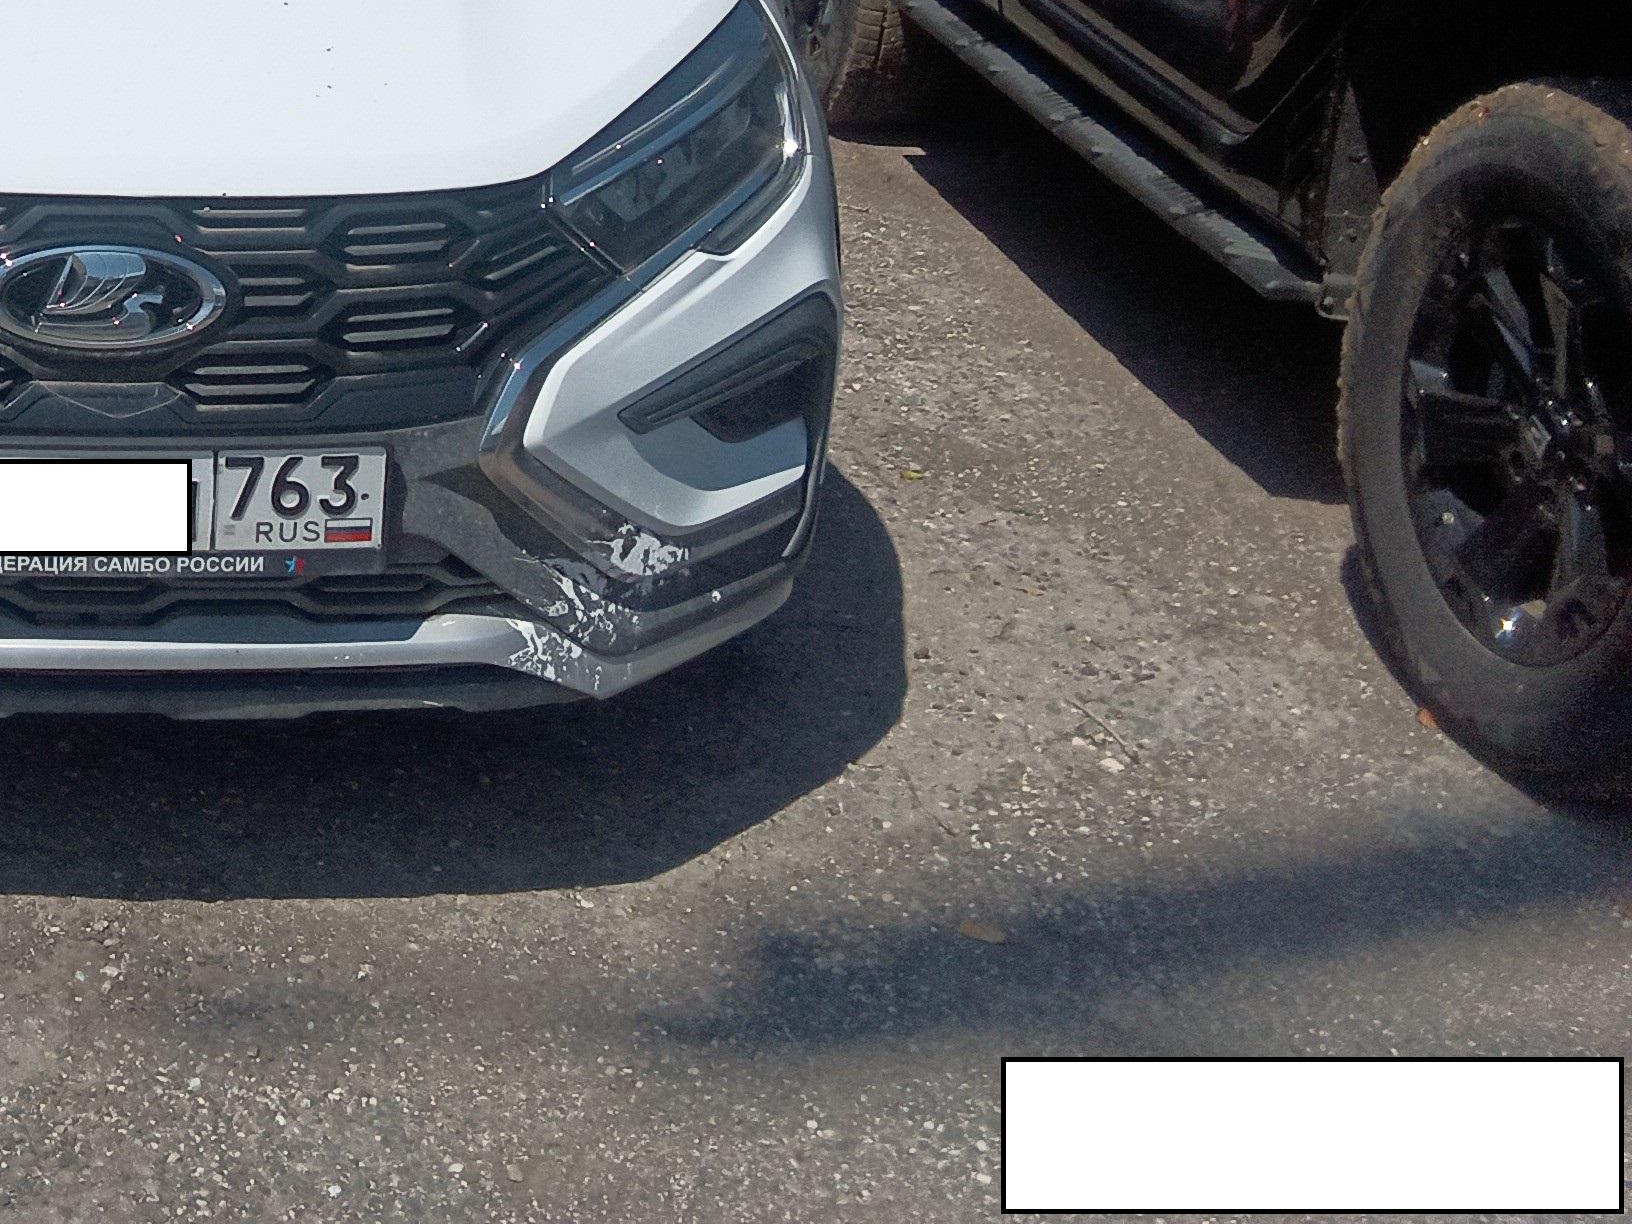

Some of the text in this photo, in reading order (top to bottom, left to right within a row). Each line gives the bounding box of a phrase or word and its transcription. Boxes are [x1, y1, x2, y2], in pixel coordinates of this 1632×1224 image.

[225, 455, 360, 520] 763
[255, 521, 321, 543] RUS
[94, 556, 170, 572] САМБО
[176, 556, 265, 572] РОССИИ
